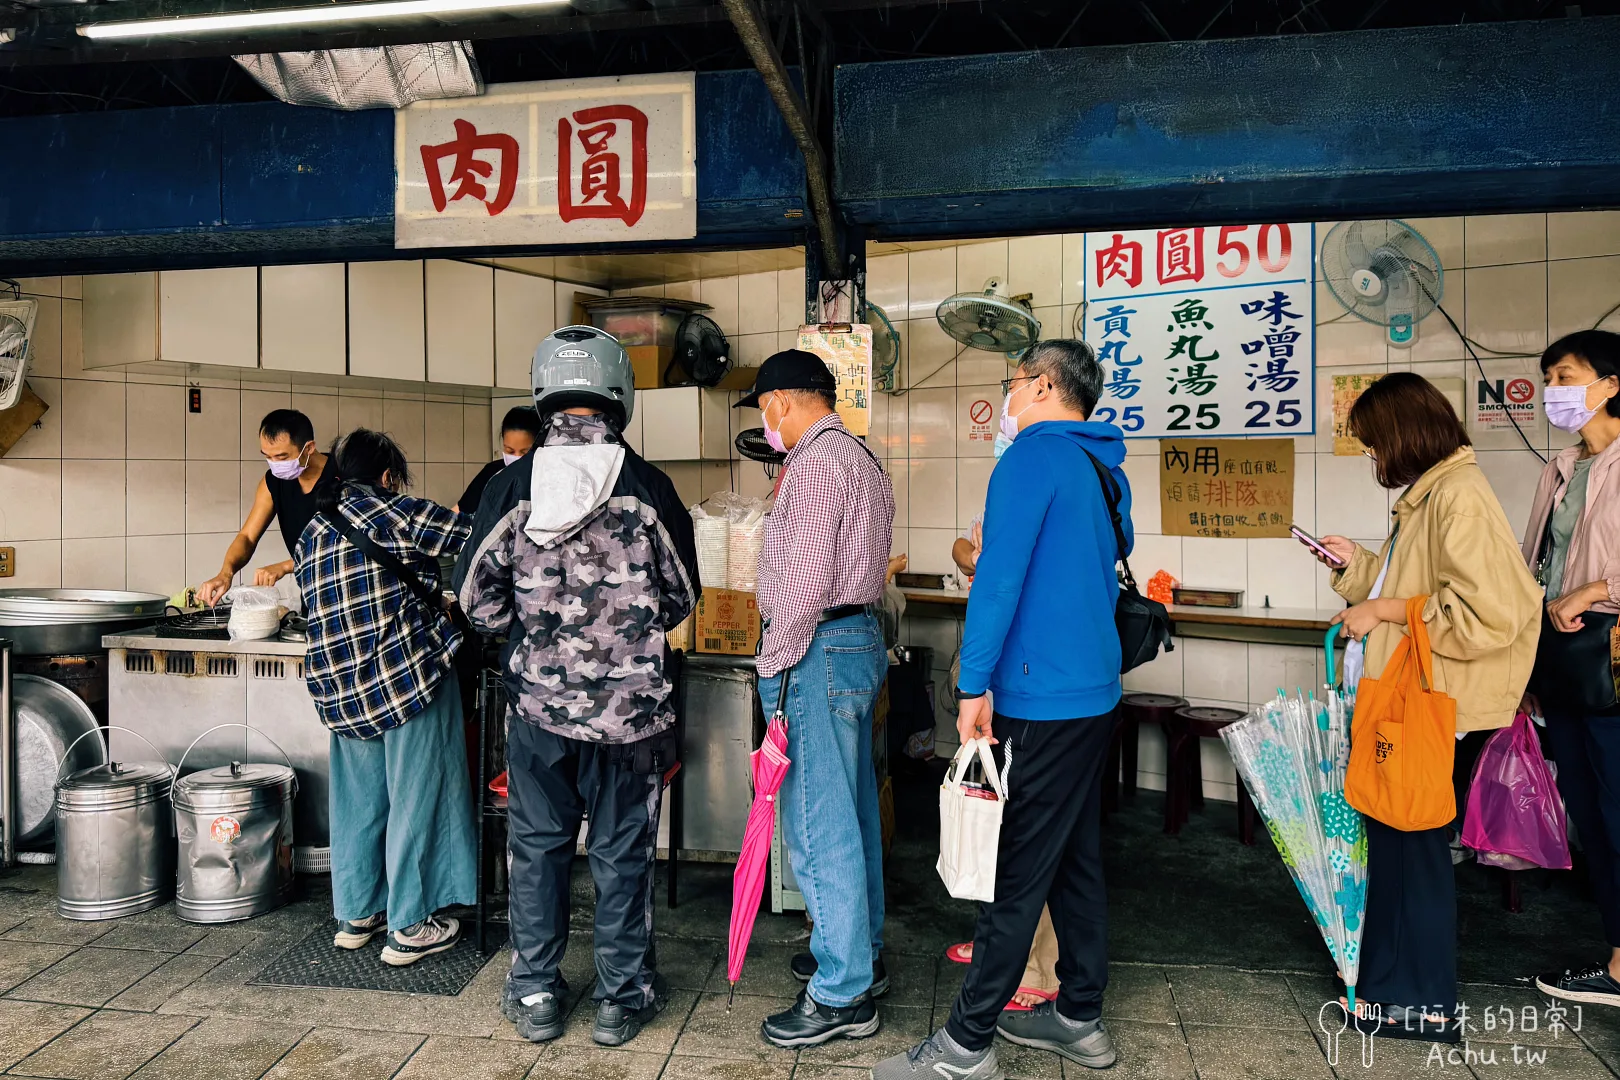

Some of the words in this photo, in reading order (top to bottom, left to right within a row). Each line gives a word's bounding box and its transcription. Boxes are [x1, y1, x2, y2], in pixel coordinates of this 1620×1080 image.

[420, 104, 648, 227] 肉圓
[1164, 299, 1220, 397] 魚丸湯
[1240, 291, 1304, 393] 味噌湯
[1095, 406, 1145, 432] 25
[1166, 403, 1221, 431] 25
[1244, 399, 1303, 428] 25
[1478, 403, 1535, 411] SMOKING
[713, 621, 740, 629] PEPPER
